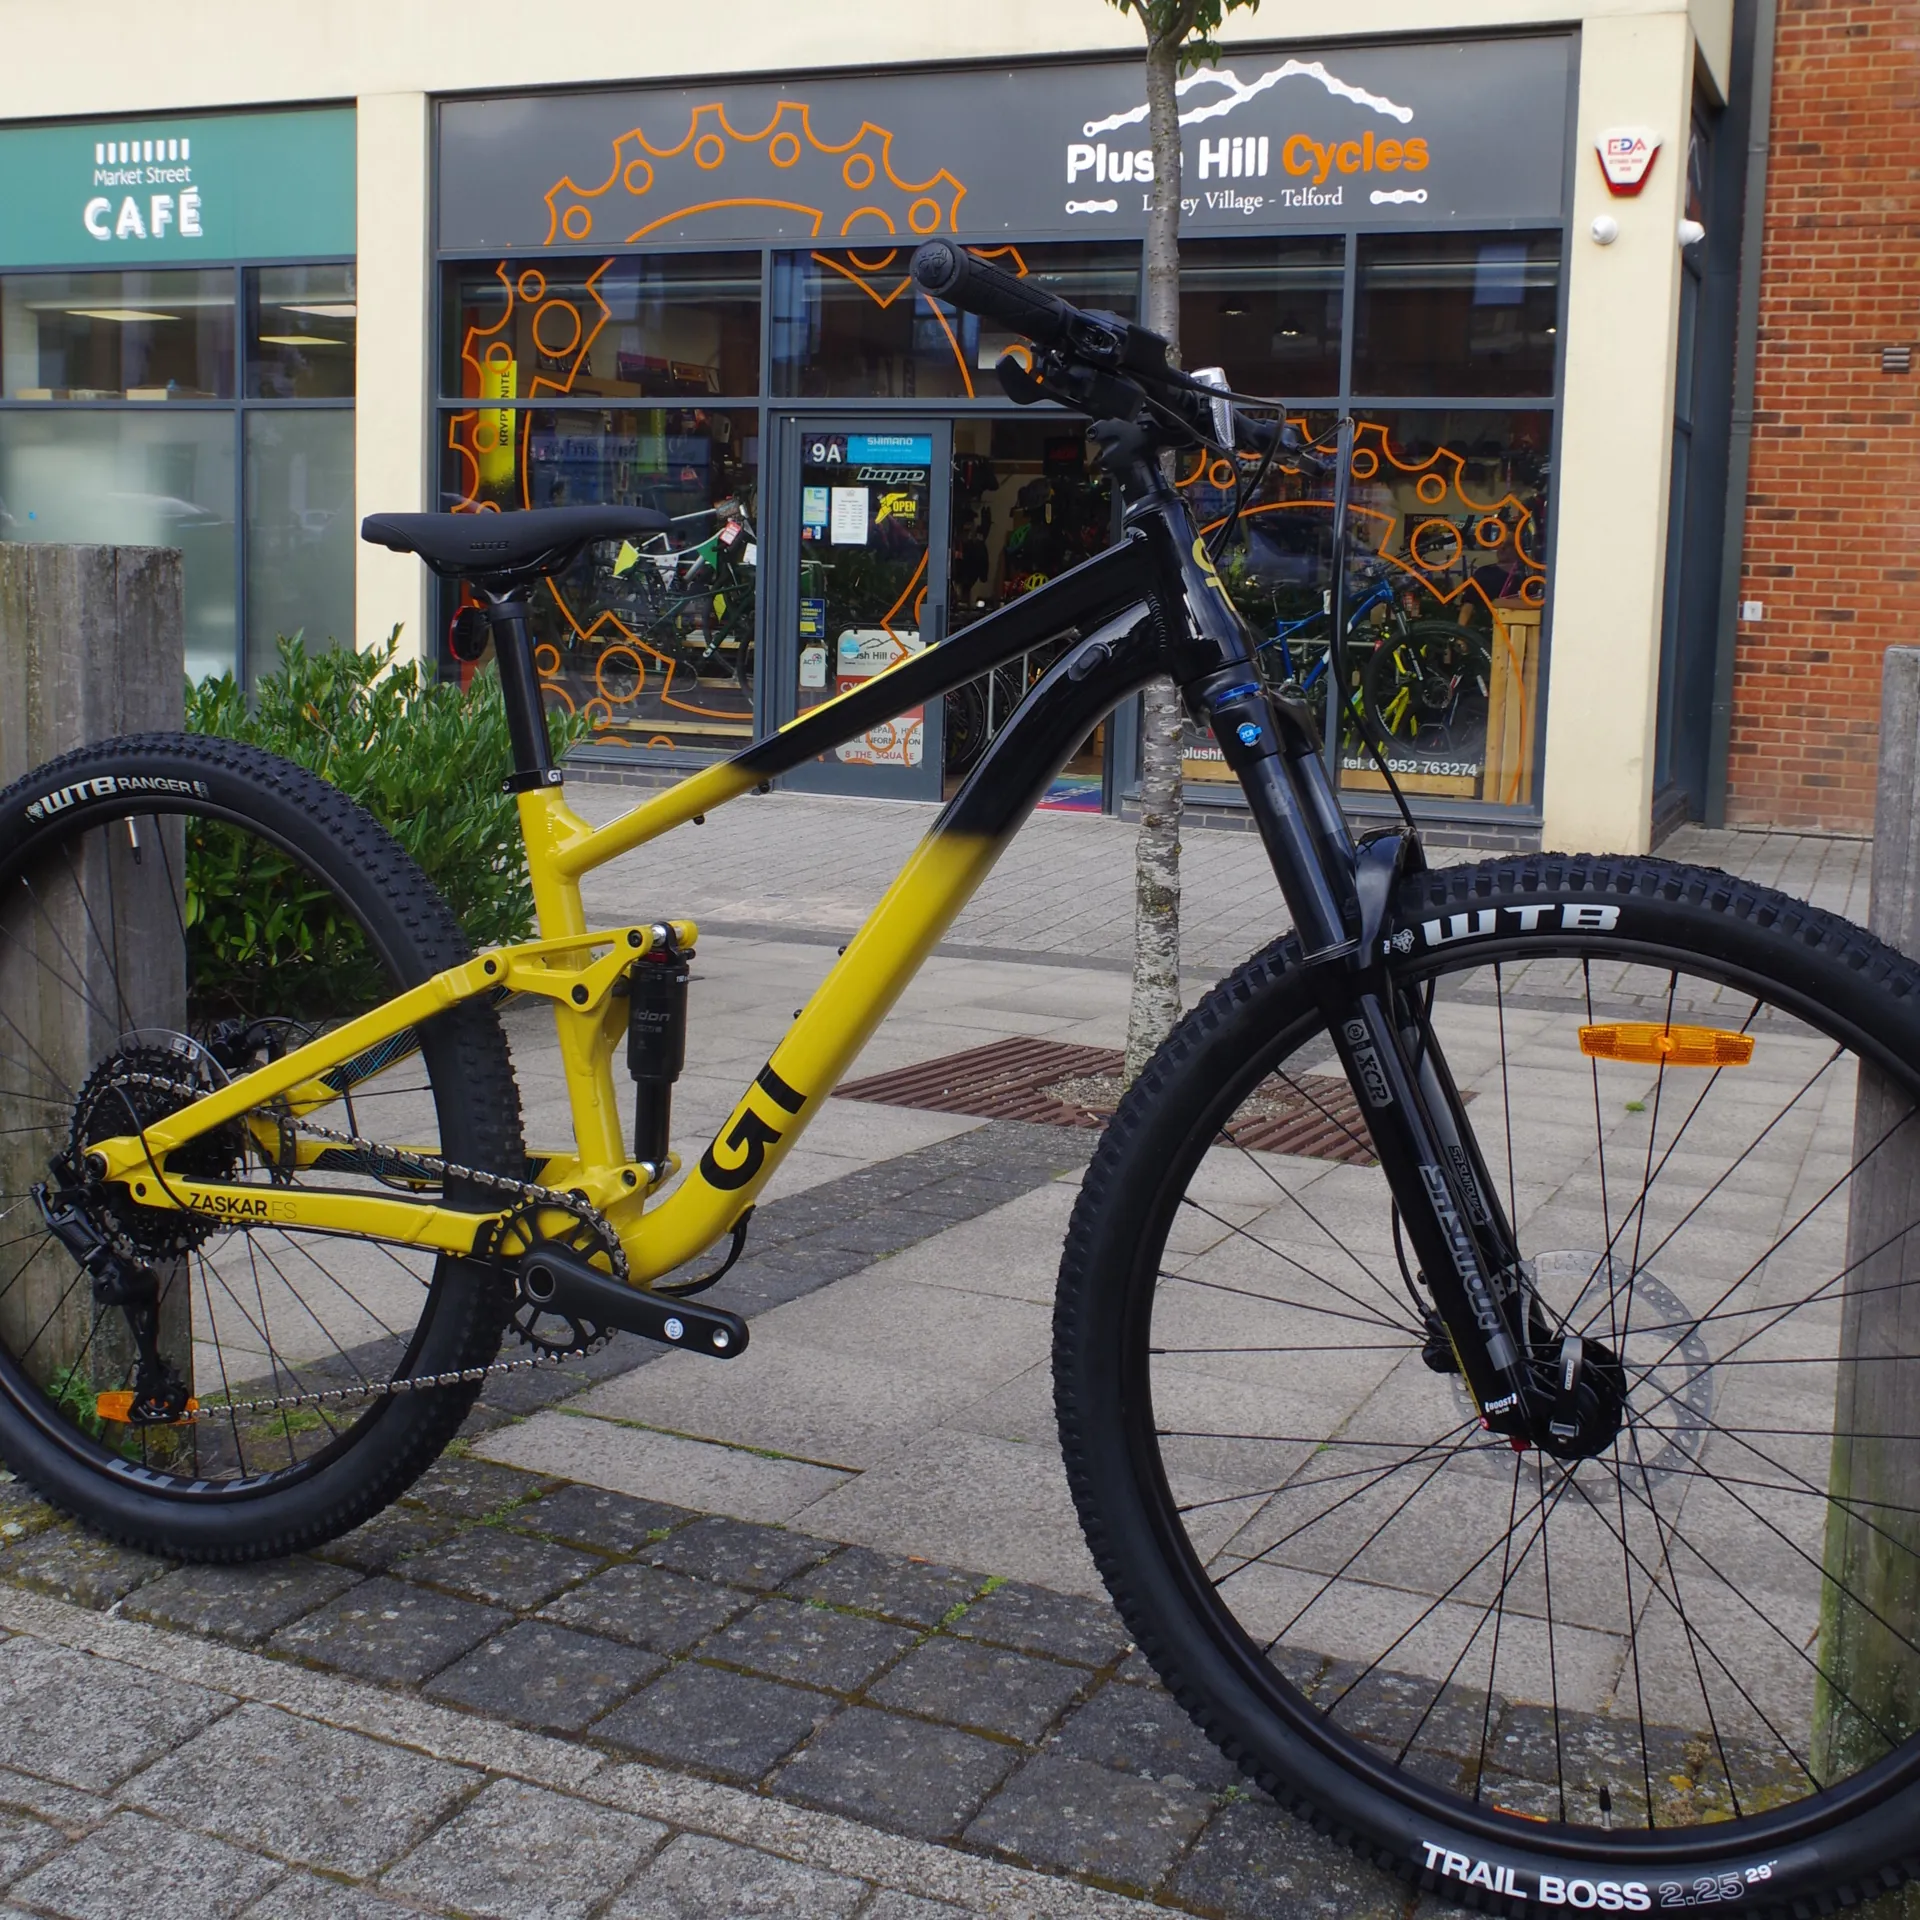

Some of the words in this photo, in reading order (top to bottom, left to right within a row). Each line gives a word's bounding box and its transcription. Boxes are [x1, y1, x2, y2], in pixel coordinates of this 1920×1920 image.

[1067, 143, 1183, 184] Plus
[1198, 135, 1269, 179] Hill
[1282, 131, 1430, 185] Cycles
[94, 167, 142, 186] Market
[146, 165, 192, 183] Street
[83, 186, 203, 240] CAFÉ
[1204, 190, 1263, 215] Village
[1281, 186, 1343, 207] Telford
[500, 371, 510, 446] KRYPTNITE
[812, 443, 841, 463] 9A
[893, 501, 916, 512] OPEN
[873, 652, 888, 660] Hill
[876, 752, 915, 760] SQUAE
[1343, 757, 1364, 769] tel.
[1369, 758, 1417, 773] 0952
[1421, 761, 1477, 776] 763274
[547, 769, 563, 782] GT
[40, 776, 117, 814] WTB
[117, 777, 193, 794] RANGER
[1421, 903, 1621, 947] WTB
[1356, 1053, 1390, 1103] XCR
[190, 1192, 268, 1217] ZASKAR
[271, 1200, 297, 1219] FS
[1440, 1211, 1500, 1330] SUNTOUR
[1422, 1841, 1527, 1898] TRAIL
[1539, 1875, 1652, 1911] BOSS
[1659, 1872, 1745, 1908] 2.25
